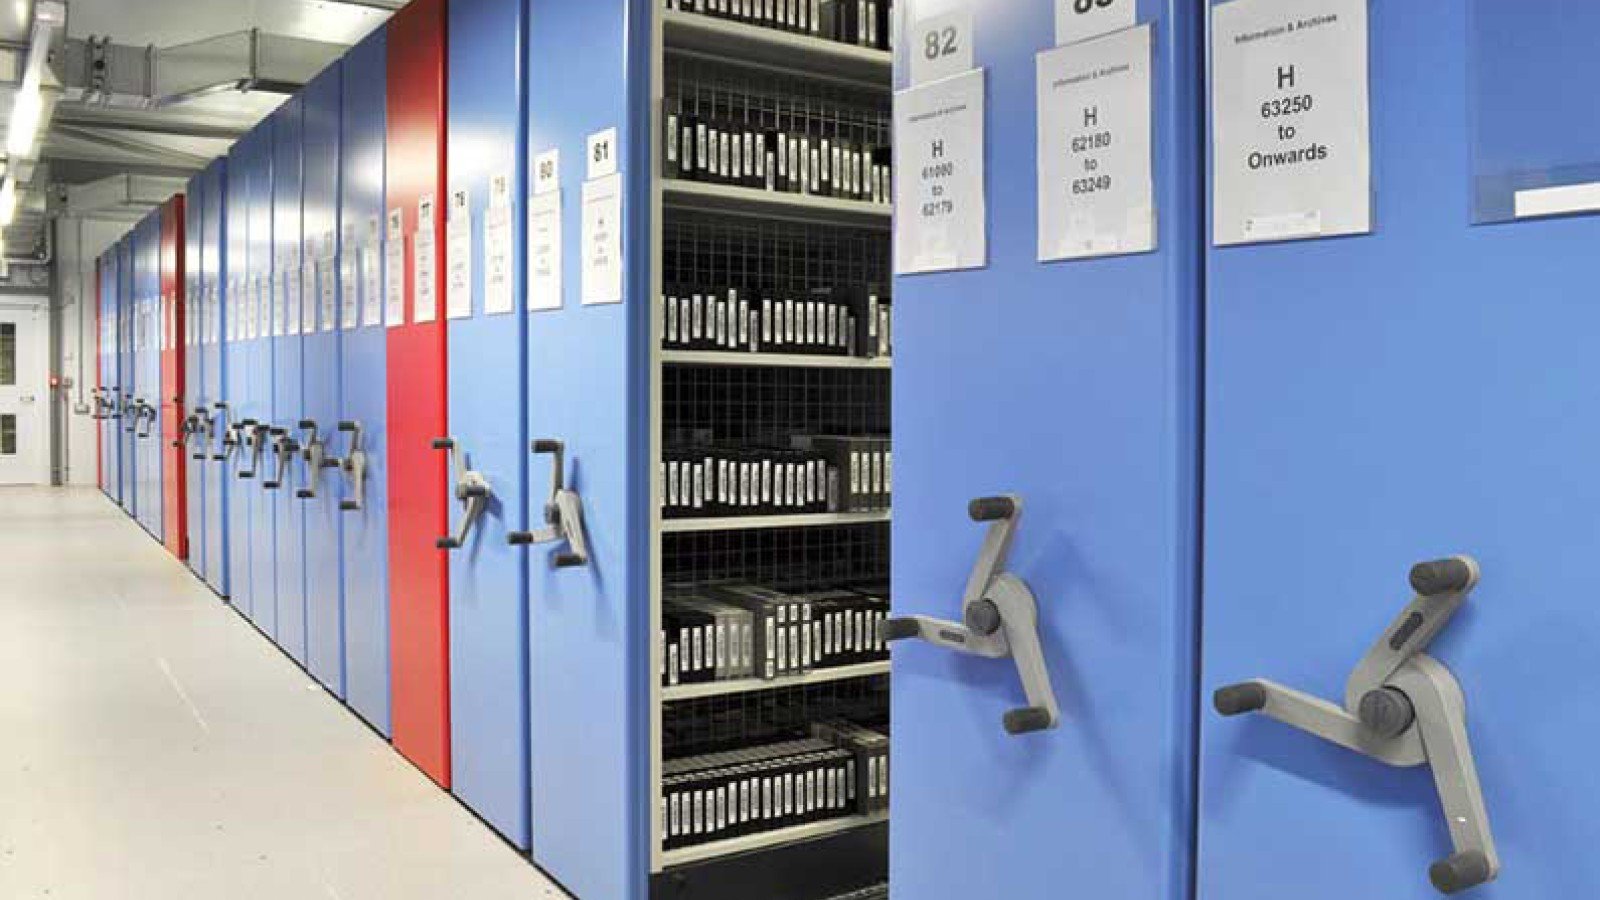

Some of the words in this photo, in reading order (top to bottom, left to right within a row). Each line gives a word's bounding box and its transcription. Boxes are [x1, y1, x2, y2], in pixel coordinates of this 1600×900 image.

[1235, 27, 1285, 44] Information
[1287, 22, 1295, 32] &
[1297, 14, 1337, 30] Archives
[925, 26, 957, 60] 82
[1277, 64, 1295, 89] H
[1084, 105, 1098, 127] H
[1261, 95, 1313, 119] 63250
[1277, 125, 1296, 141] to
[594, 141, 609, 162] 81
[931, 140, 943, 157] H
[1247, 143, 1328, 169] Onwards
[1084, 158, 1098, 170] to
[931, 185, 943, 196] to
[1072, 175, 1111, 194] 63249
